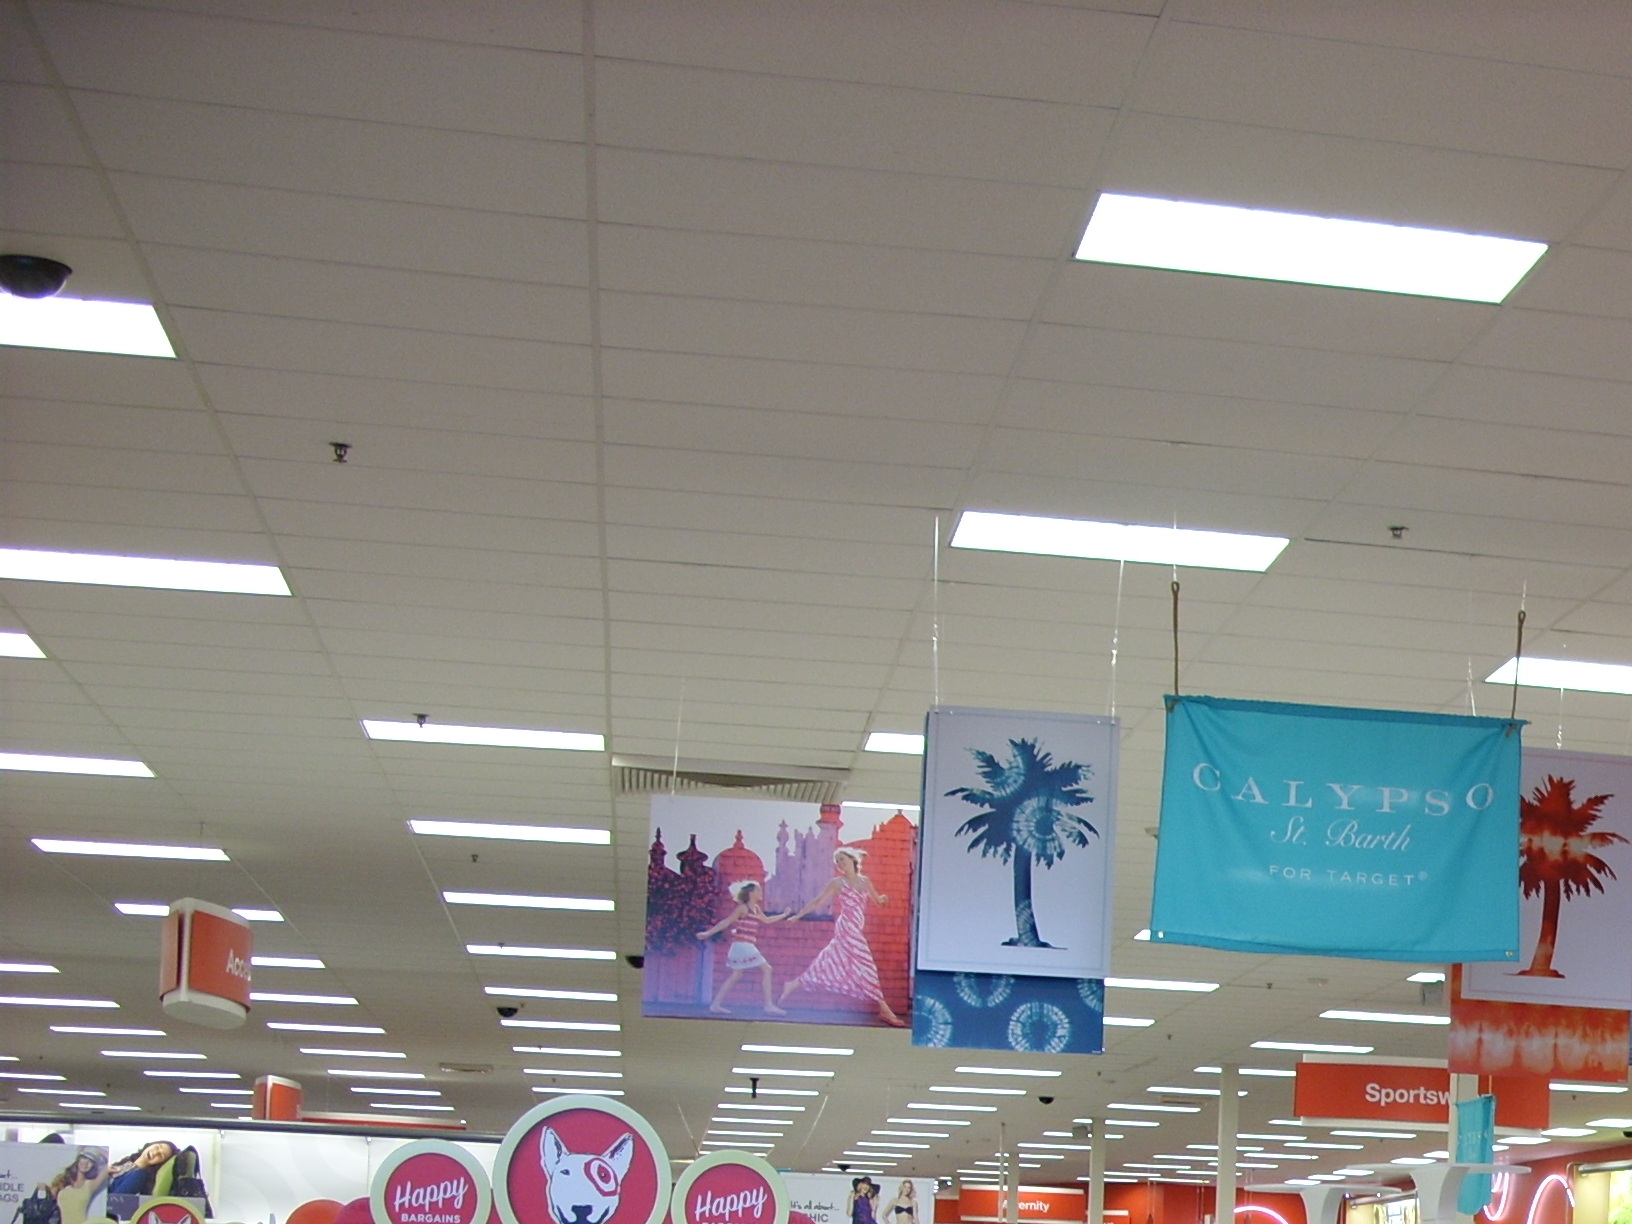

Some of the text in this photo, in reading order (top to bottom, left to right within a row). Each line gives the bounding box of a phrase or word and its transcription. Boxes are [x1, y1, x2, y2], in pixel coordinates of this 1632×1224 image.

[1192, 763, 1496, 817] CALYPSO
[1270, 816, 1412, 851] St. Barth
[1269, 865, 1312, 881] FOR
[1365, 1083, 1451, 1107] Sportsw
[394, 1175, 469, 1211] Happy
[694, 1186, 768, 1222] Happy
[401, 1213, 461, 1224] BARGAINS
